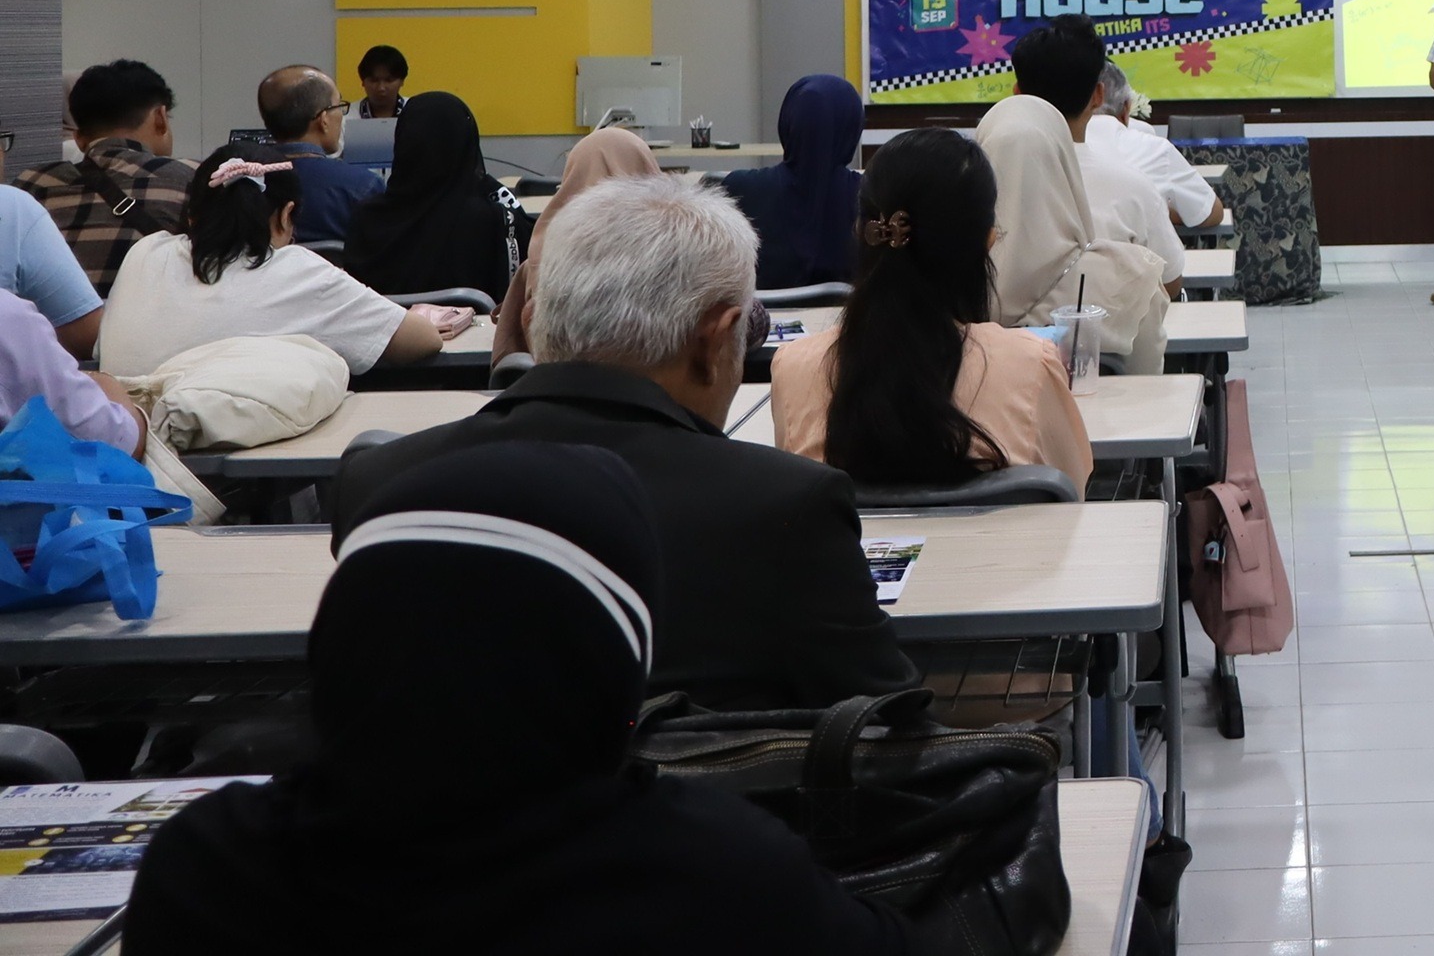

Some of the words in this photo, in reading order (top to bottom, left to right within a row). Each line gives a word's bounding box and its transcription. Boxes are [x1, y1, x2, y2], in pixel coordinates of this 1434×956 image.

[921, 10, 947, 23] SEP
[1094, 18, 1142, 36] ATIKA
[1145, 17, 1171, 34] ITS
